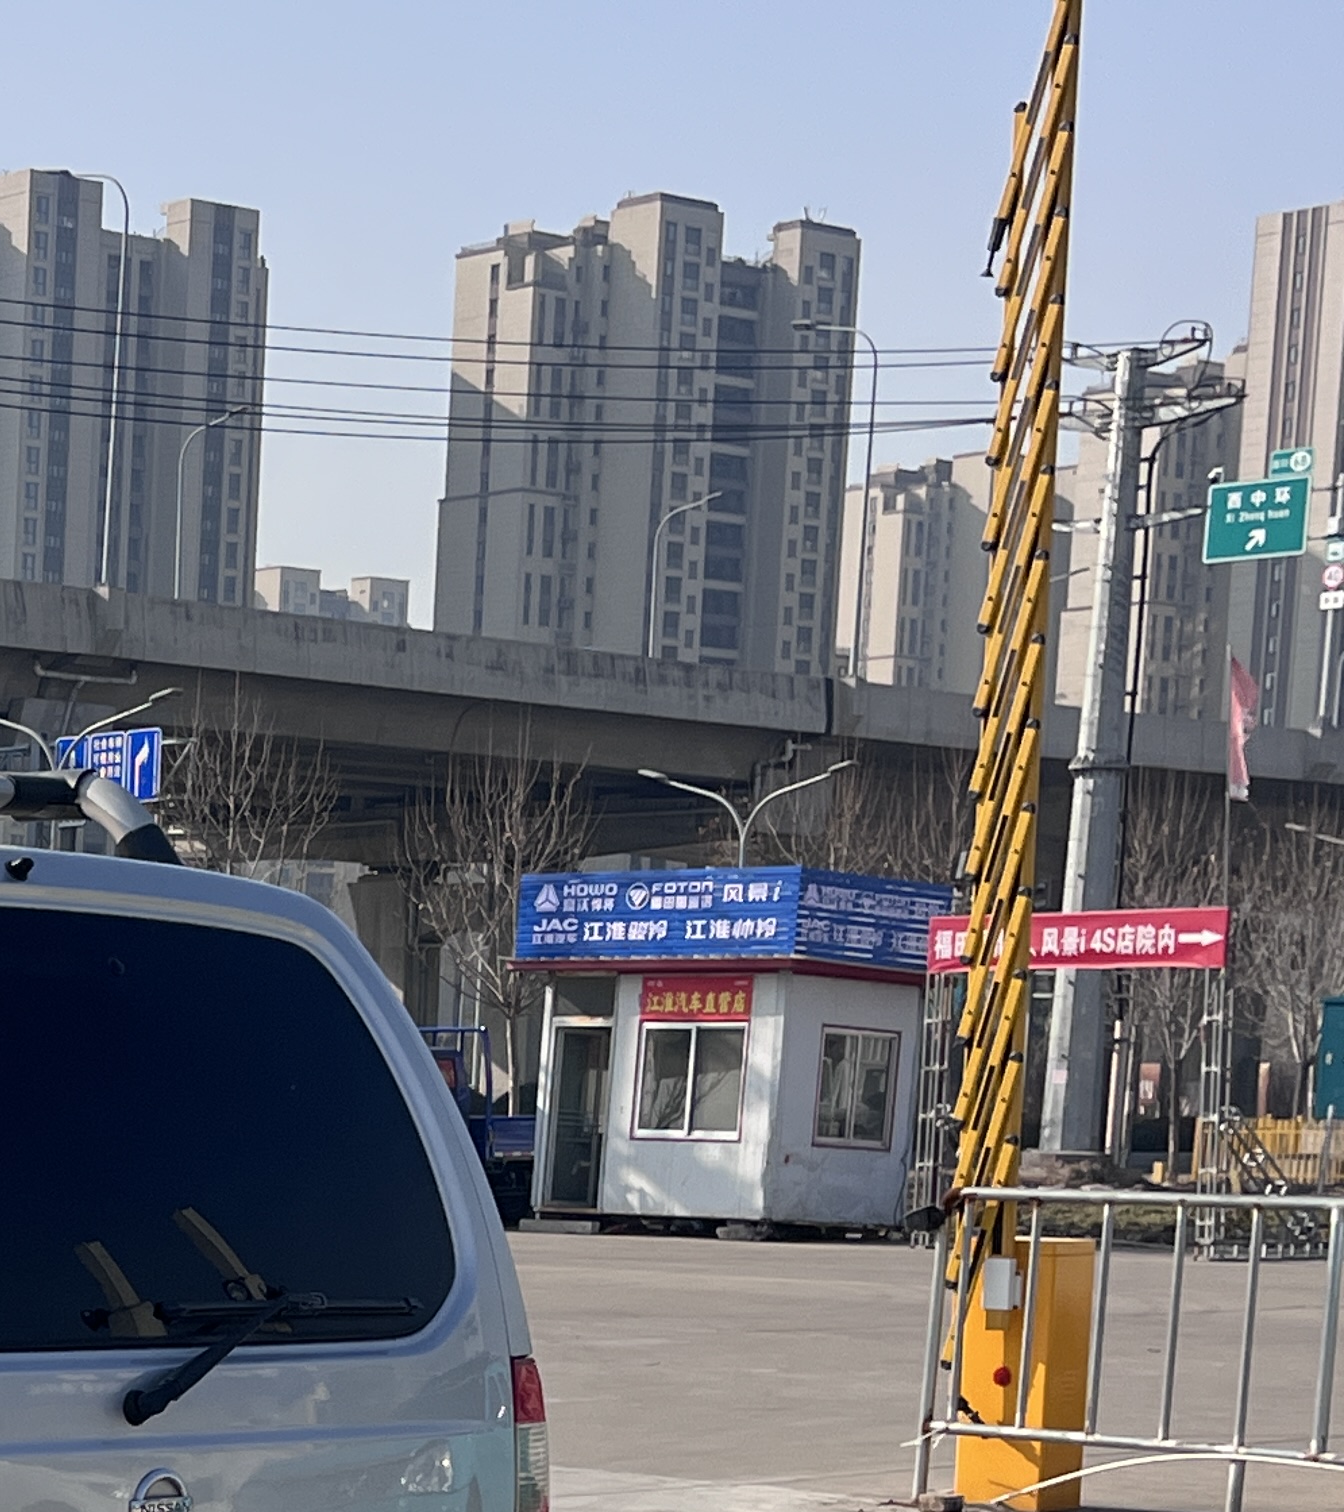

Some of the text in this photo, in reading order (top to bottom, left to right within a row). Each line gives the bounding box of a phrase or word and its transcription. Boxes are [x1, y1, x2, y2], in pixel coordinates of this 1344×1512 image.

[563, 883, 618, 897] HOWO
[652, 881, 714, 894] FOTON
[533, 918, 579, 932] JAC
[645, 989, 746, 1014] 江淮汽车直营店
